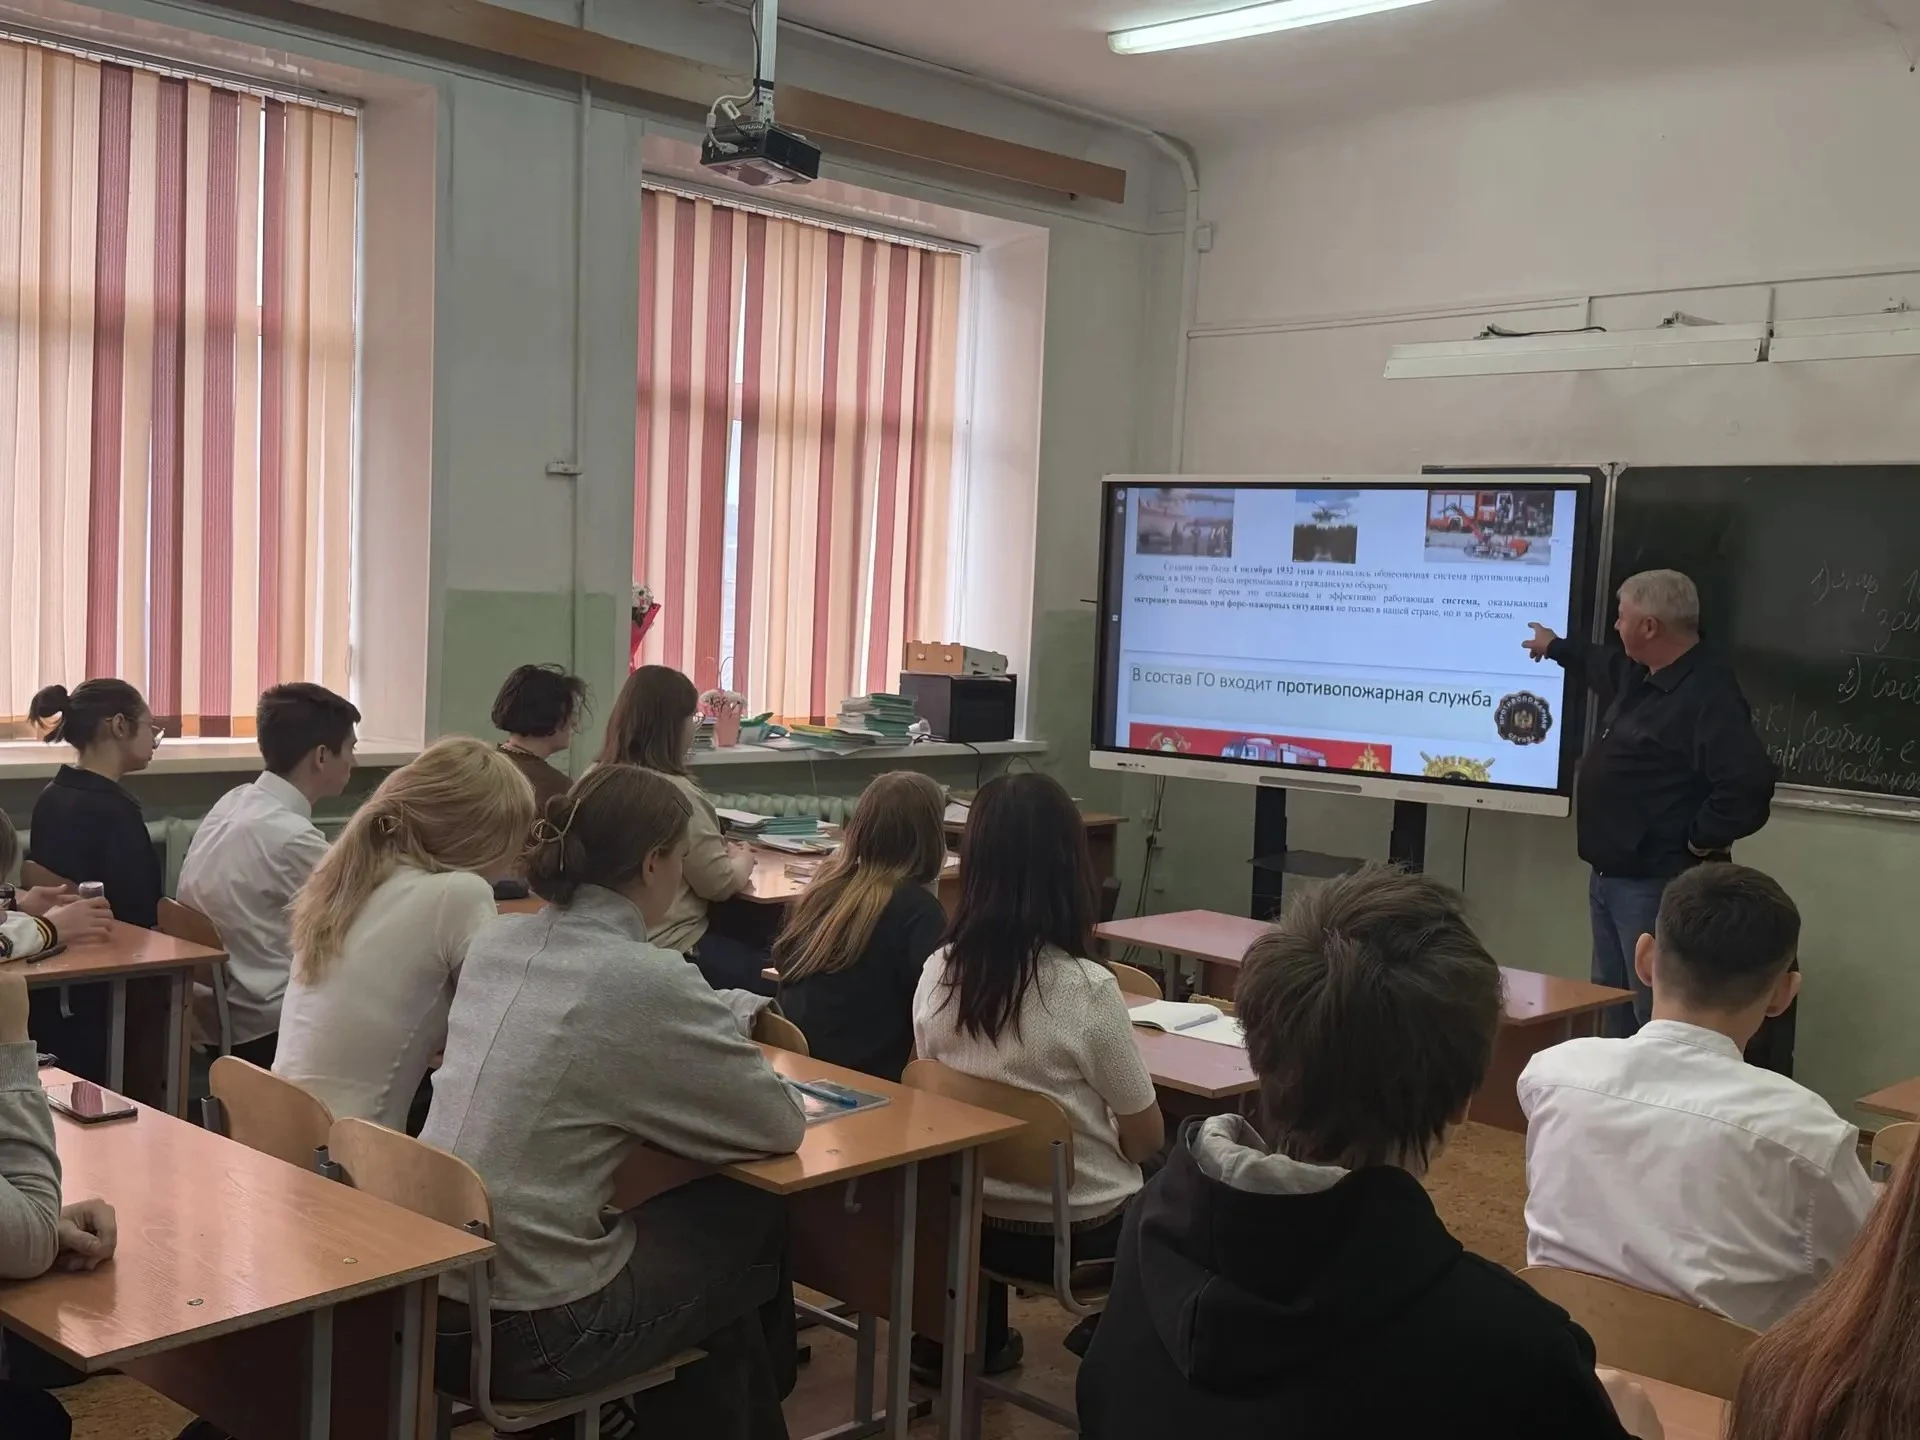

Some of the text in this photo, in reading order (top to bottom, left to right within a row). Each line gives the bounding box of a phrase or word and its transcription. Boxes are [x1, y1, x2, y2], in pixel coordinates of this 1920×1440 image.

[1433, 571, 1467, 581] система
[1470, 573, 1550, 584] противопожарной
[1383, 594, 1434, 604] работающая
[1441, 597, 1480, 607] система,
[1487, 599, 1549, 609] оказывающая
[1132, 667, 1492, 708] В состав ГО входит противопожарная служба
